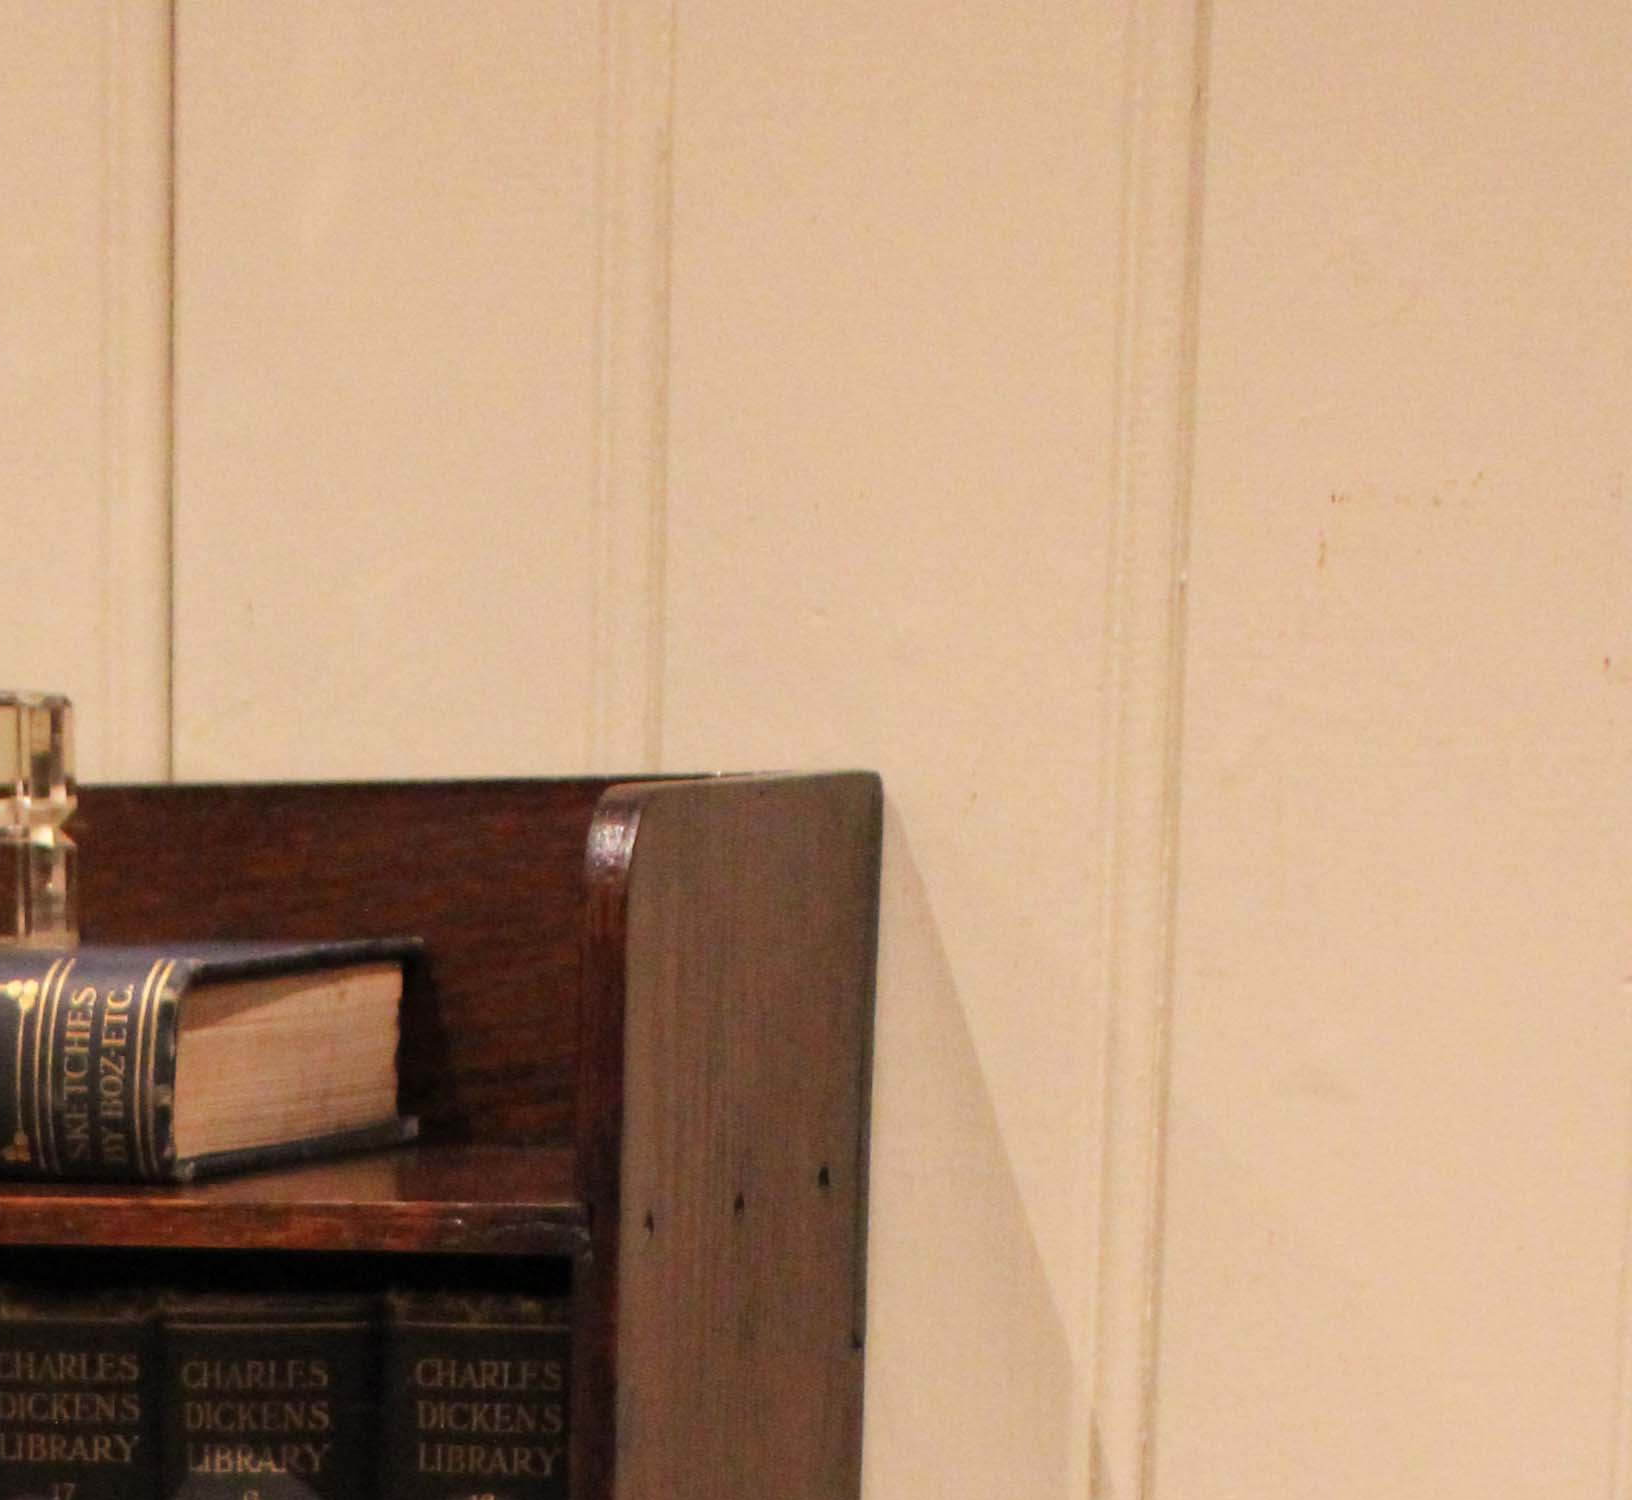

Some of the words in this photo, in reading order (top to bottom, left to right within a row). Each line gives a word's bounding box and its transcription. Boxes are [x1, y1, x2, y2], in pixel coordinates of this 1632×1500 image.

[64, 986, 96, 1159] SKETCHES
[182, 1360, 329, 1390] CHARLES
[416, 1359, 563, 1391] CHARLES
[184, 1402, 330, 1431] DICKENS
[417, 1401, 565, 1433] DICKENS
[187, 1443, 330, 1473] LIBRARY
[418, 1443, 562, 1477] LIBRARY
